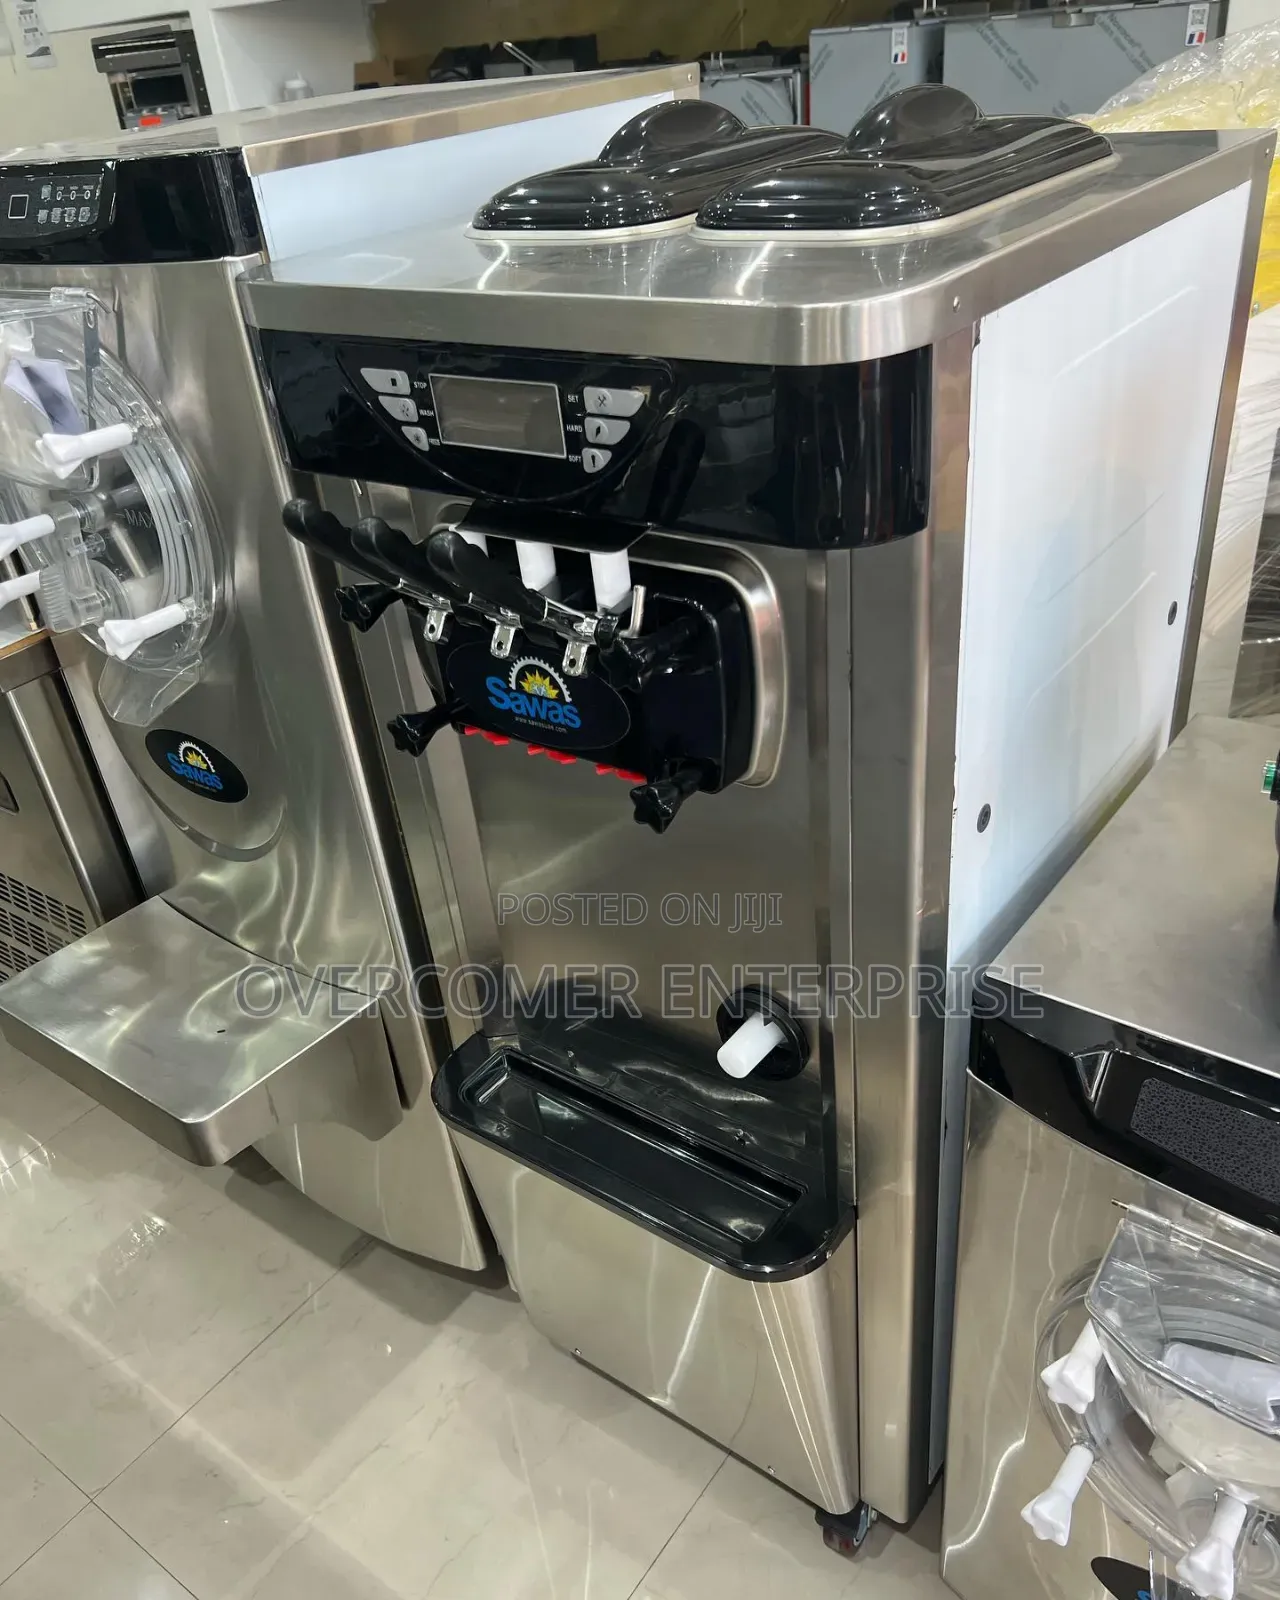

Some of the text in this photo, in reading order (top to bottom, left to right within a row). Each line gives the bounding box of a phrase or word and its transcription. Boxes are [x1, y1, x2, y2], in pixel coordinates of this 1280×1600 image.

[413, 381, 428, 389] STOP
[567, 394, 579, 403] SET
[419, 408, 435, 417] WASH
[566, 424, 583, 433] HARD
[568, 455, 582, 463] SOFT
[486, 676, 581, 729] Sawas
[166, 752, 224, 790] Sawas
